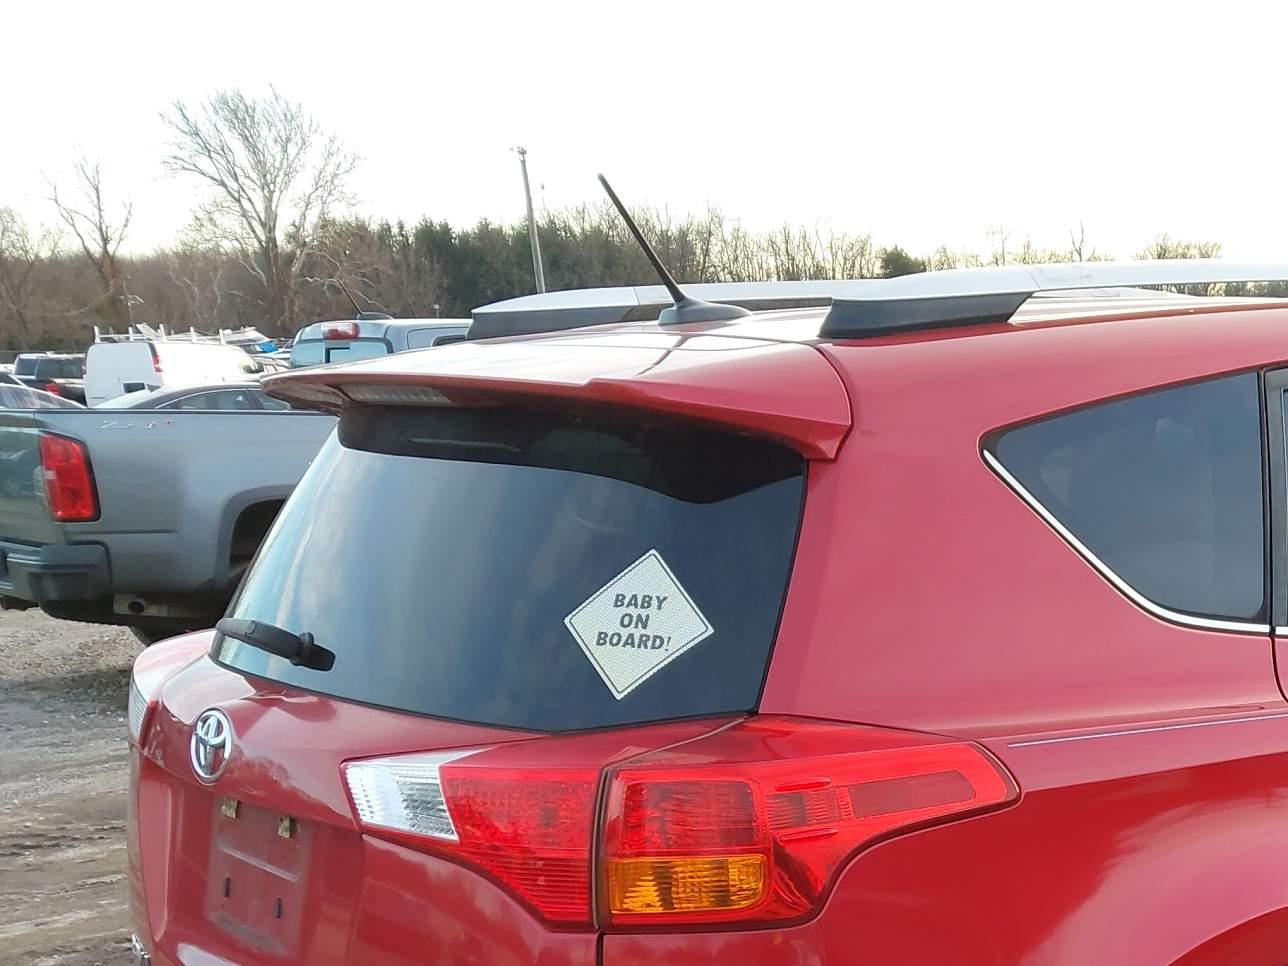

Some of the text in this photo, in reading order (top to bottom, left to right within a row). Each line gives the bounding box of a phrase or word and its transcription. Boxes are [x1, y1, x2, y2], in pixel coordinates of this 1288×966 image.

[612, 592, 669, 611] BABY
[618, 612, 651, 631] ON
[596, 631, 672, 652] BOARD!
